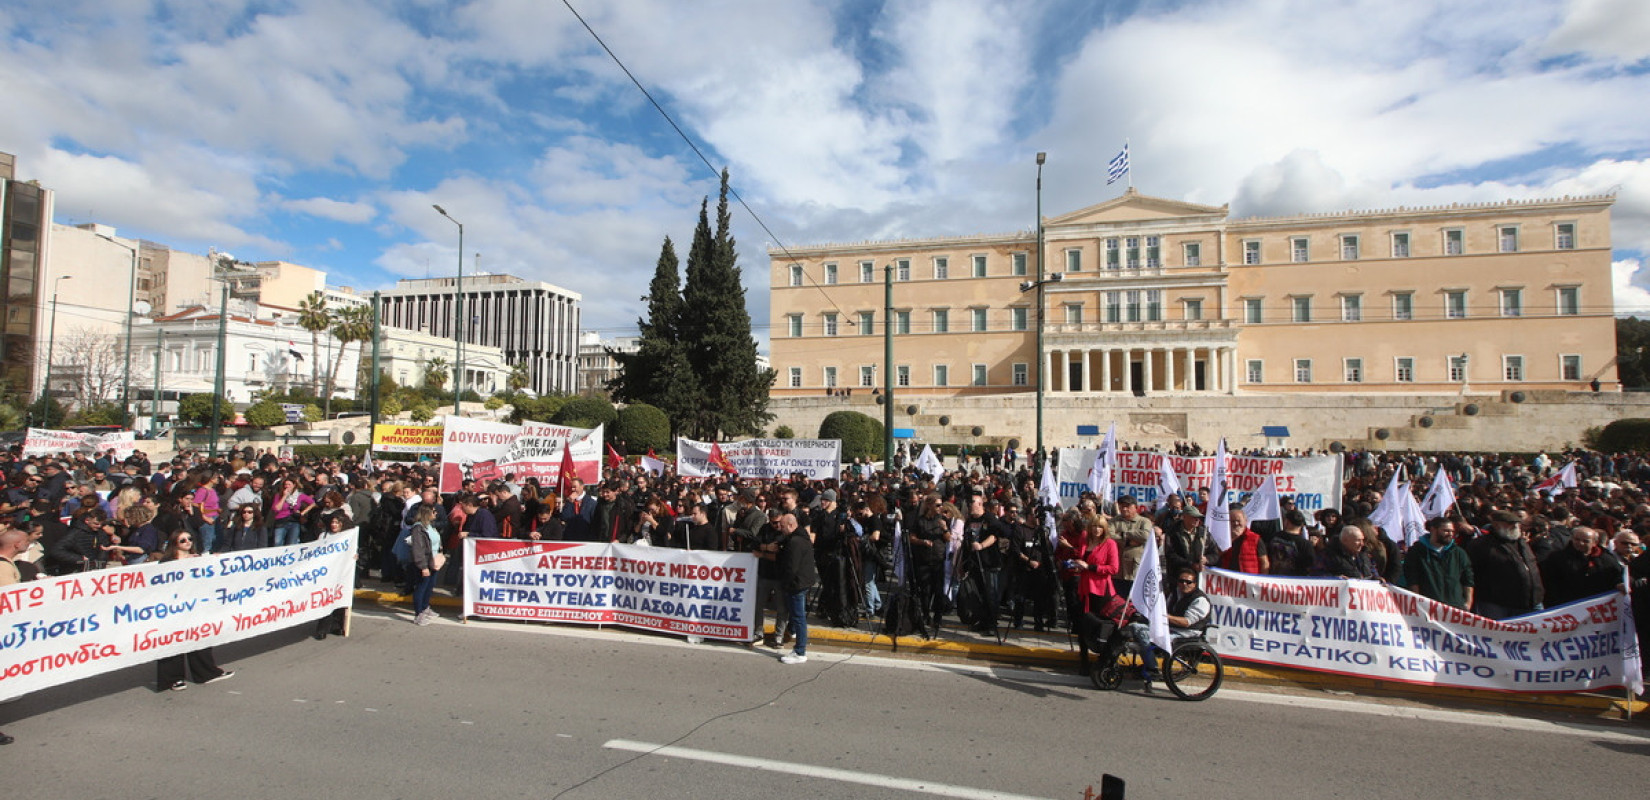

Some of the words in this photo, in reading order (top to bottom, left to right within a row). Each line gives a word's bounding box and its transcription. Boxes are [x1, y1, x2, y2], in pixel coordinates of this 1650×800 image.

[382, 435, 421, 444] ΜΠΛΟΚΟ
[394, 428, 444, 436] ΑΠΕΡΓΙΑΚ
[448, 431, 519, 444] ΔΟΥΛΕΥΟΥΜ
[536, 428, 572, 438] ΖΟΥΜΕ
[542, 439, 557, 447] ΓΙΑ
[760, 459, 778, 467] ΤΟΥΣ
[781, 459, 813, 467] ΑΓΩΝΕΣ
[816, 460, 836, 468] ΤΟΥΣ
[1122, 469, 1182, 486] ΠΕΛΑΤ
[1186, 476, 1211, 491] ΣΤΙ
[478, 544, 544, 563] ΔΙΕΚΔΙΚΟΥΜΕ
[537, 555, 618, 571] ΑΥΞΗΣΕΙΣ
[620, 558, 667, 577] ΣΤΟΥΣ
[669, 563, 747, 583] ΜΙΣΘΟΥΣ
[0, 586, 44, 615] ΑΤΩ
[55, 579, 84, 601] ΤΑ
[91, 571, 146, 597] ΧΕΡΙΑ
[190, 565, 215, 578] τις
[219, 549, 296, 577] Συλλογικές
[479, 569, 548, 587] ΜΕΙΩΣΗ
[553, 573, 588, 588] ΤΟΥ
[590, 575, 656, 594] ΧΡΟΝΟΥ
[659, 581, 745, 603] ΕΡΓΑΣΙΑΣ
[1205, 574, 1248, 598] ΚΑΜΙΑ
[1348, 587, 1425, 617] ΣΥΜΦΩΝΙΑ"
[0, 614, 100, 649] υξήσεις
[114, 594, 197, 624] Μισθών
[216, 587, 256, 606] 7ωρο
[232, 600, 308, 632] Υπαλλήλων
[479, 587, 541, 603] ΜΕΤΡΑ
[545, 590, 607, 607] ΥΓΕΙΑΣ
[611, 593, 637, 610] ΚΑΙ
[640, 598, 742, 622] ΑΣΦΑΛΕΙΑΣ
[477, 605, 536, 617] ΣΥΝΔΙΚΑΤΟ
[537, 608, 604, 621] ΕΠΙΣΙΤΙΣΜΟΥ
[612, 612, 664, 627] ΤΟΥΡΙΣΜΟΥ
[669, 622, 742, 637] ΞΕΝΟΔΟΧΕΙΩΝ
[1209, 604, 1302, 636] ΥΛΛΟΓΙΚΕΣ
[1311, 615, 1405, 648] ΣΥΜΒΑΣΕΙΣ
[1411, 626, 1498, 659] ΕΡΓΑΣΙΑΣ
[1503, 640, 1532, 661] ΜΕ
[1540, 630, 1620, 661] ΑΥΞΗΣΕΙΣ
[1250, 637, 1372, 665] ΕΡΓΑΤΙΚΟ
[1388, 655, 1495, 678] ΚΕΝΤΡΟ
[1514, 665, 1611, 682] ΠΕΙΡΑΙΑ
